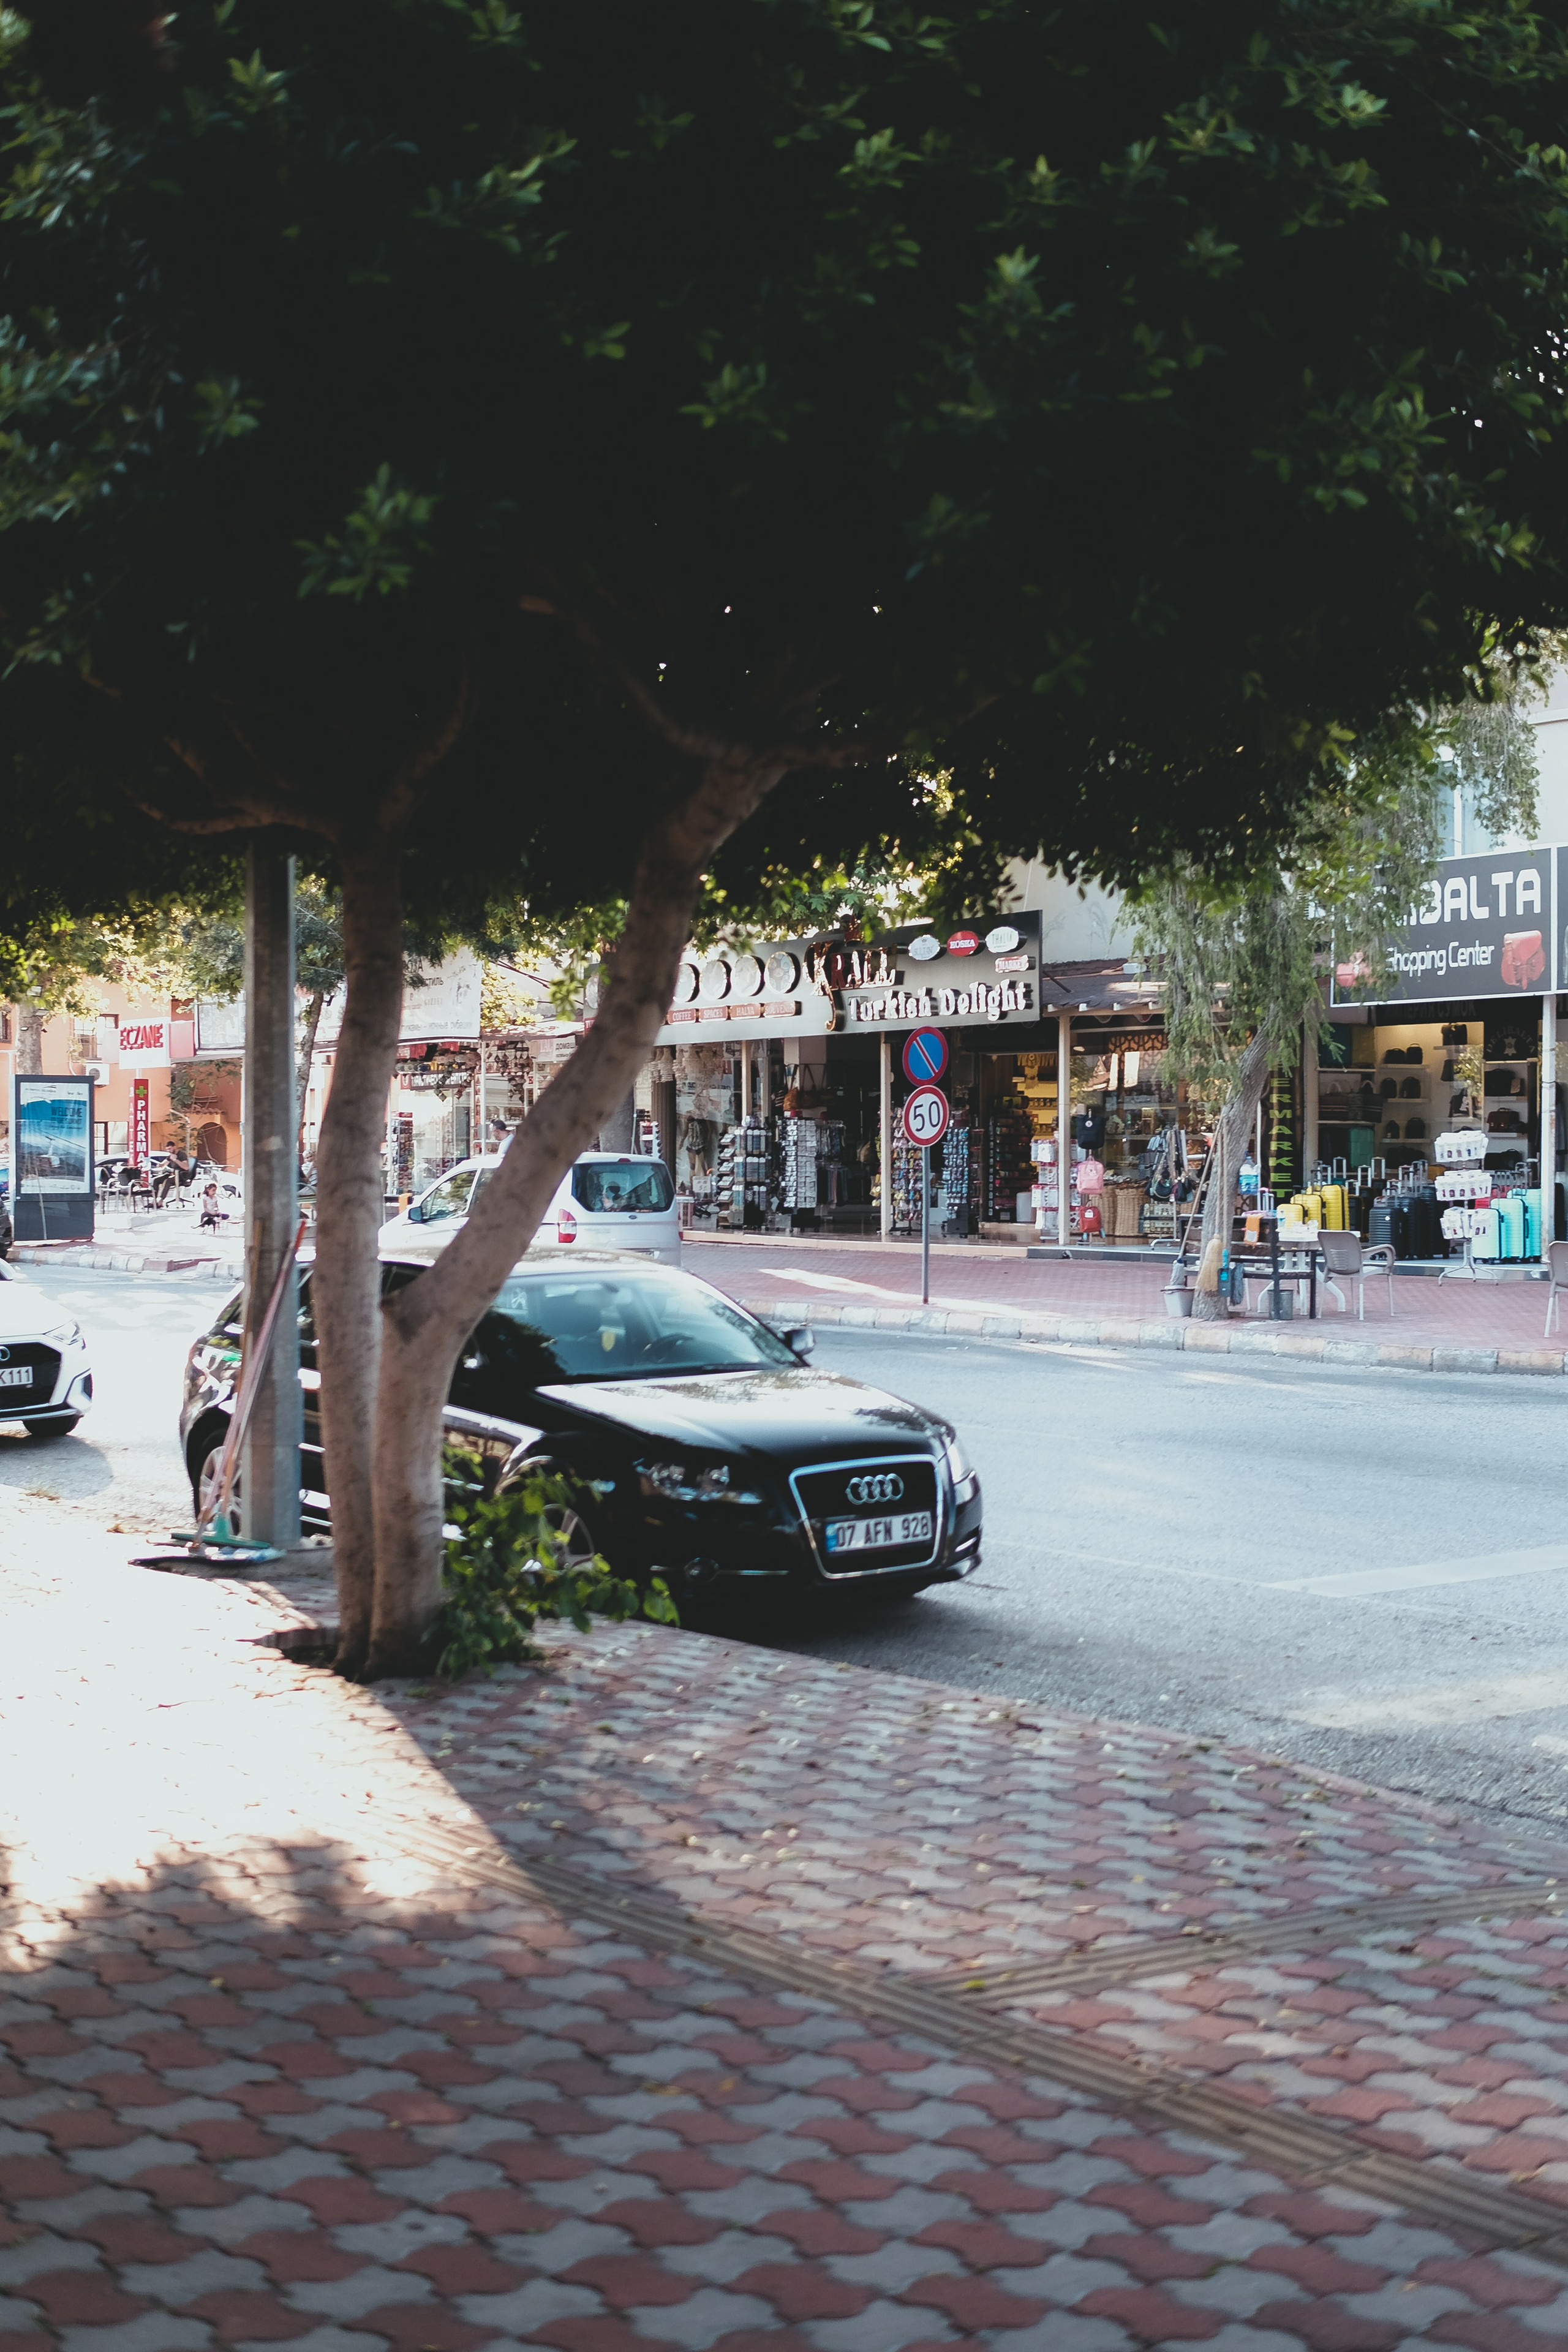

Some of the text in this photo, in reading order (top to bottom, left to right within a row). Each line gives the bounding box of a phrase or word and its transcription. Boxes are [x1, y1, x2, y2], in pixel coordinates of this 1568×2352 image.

[1385, 940, 1494, 978] Shopping Center
[736, 1006, 755, 1016] HALVA
[848, 978, 1027, 1021] Turkish Delight
[1437, 1000, 1477, 1017] СУМОК
[672, 1011, 692, 1022] COFFEE
[119, 1023, 164, 1050] ECZANE
[913, 1101, 941, 1132] 50
[1268, 1065, 1294, 1198] ERMARKET
[135, 1099, 148, 1168] PHARMA
[837, 1525, 856, 1547] 07
[902, 1515, 929, 1539] 928
